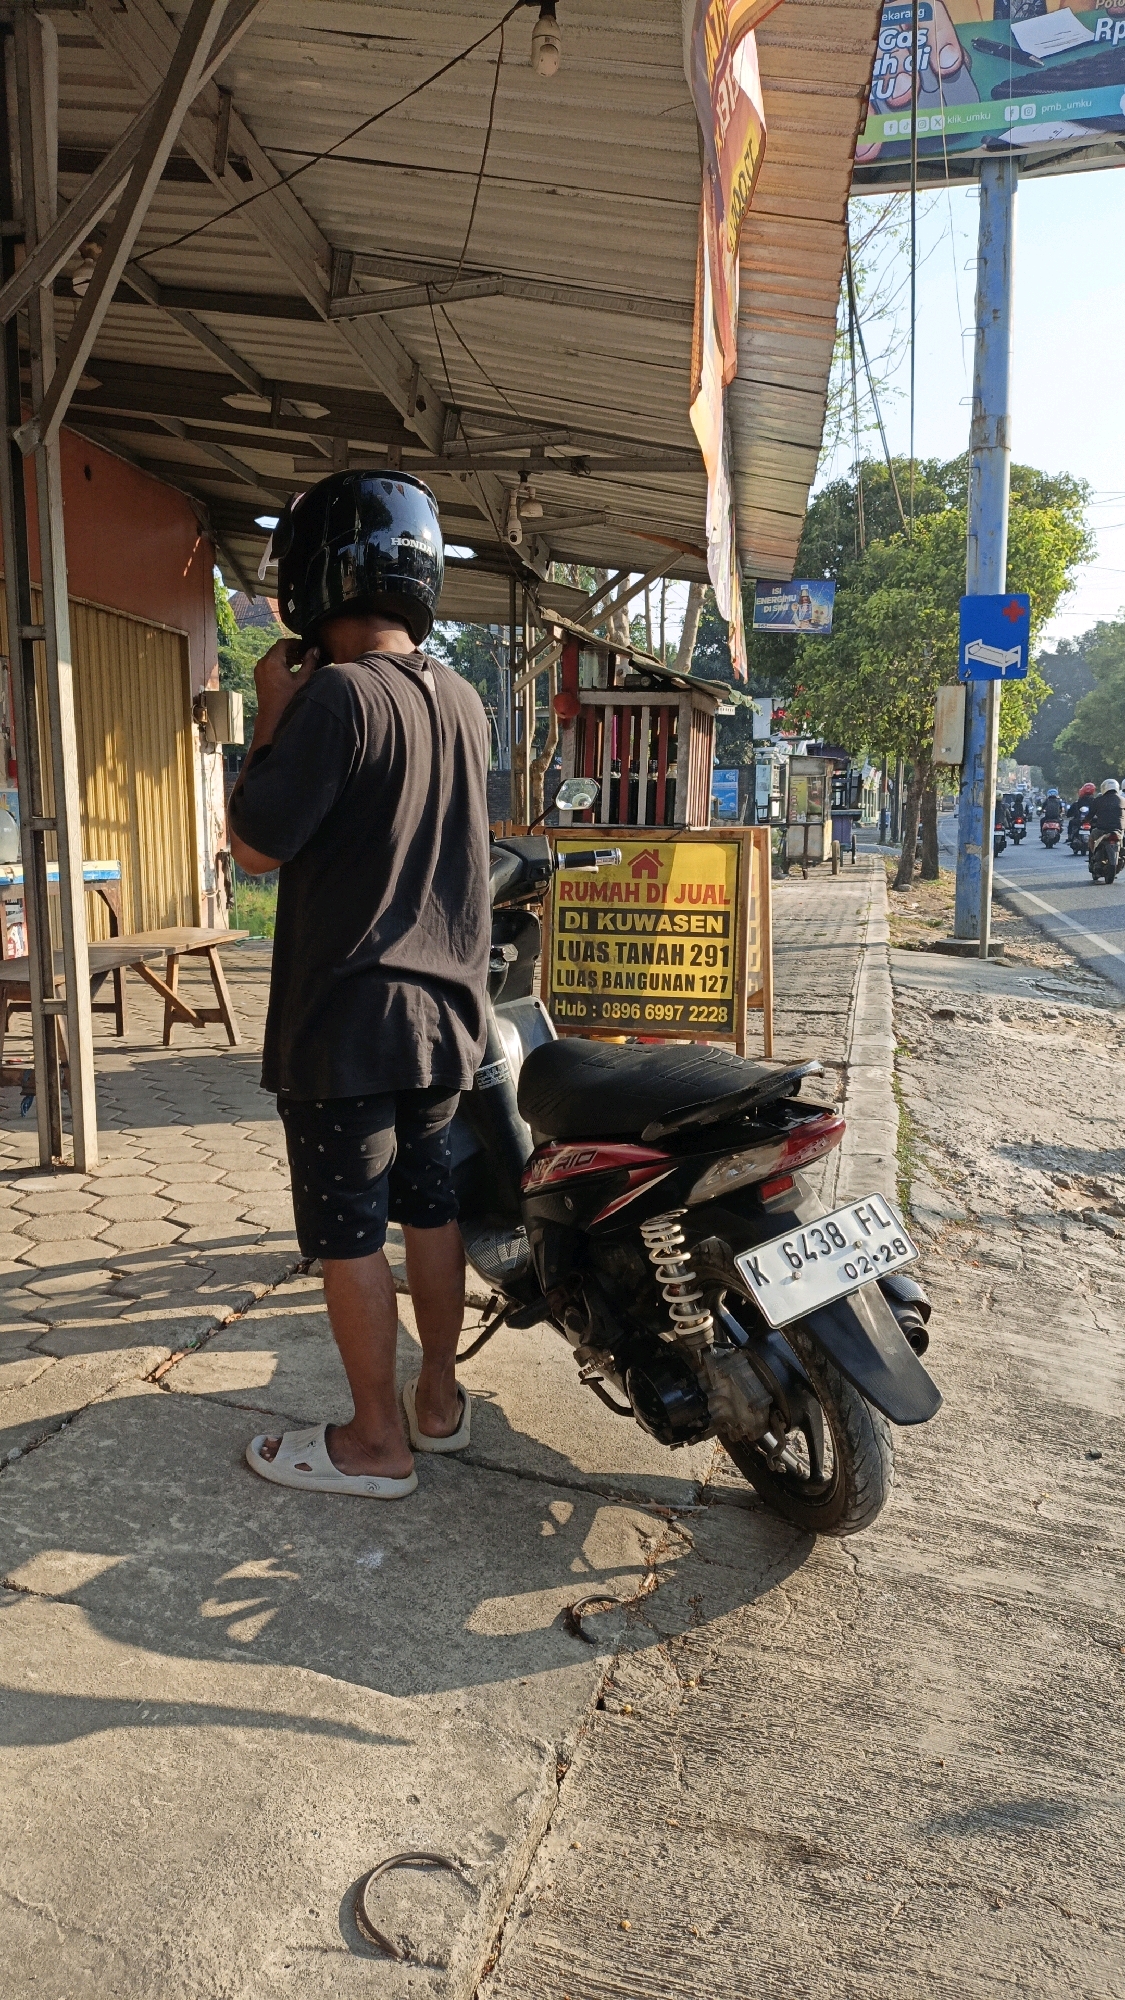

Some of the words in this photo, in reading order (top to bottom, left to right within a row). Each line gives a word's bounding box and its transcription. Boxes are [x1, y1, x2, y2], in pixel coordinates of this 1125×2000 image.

[879, 28, 929, 51] Gas
[1094, 17, 1125, 46] Rp
[947, 111, 991, 124] klik_umku
[1041, 99, 1092, 115] pmb_umku
[390, 537, 433, 557] HONDA
[756, 593, 797, 605] ENERGIMU
[772, 587, 782, 595] ISI
[763, 605, 772, 613] DI
[772, 602, 789, 612] SINI
[559, 880, 640, 904] RUMAH
[646, 882, 668, 904] DI
[673, 883, 731, 906] JUAL
[564, 911, 589, 930] DI
[597, 912, 724, 934] KUWASEN
[557, 940, 610, 964] LUAS
[615, 942, 685, 966] TANAH
[689, 943, 730, 968] 291
[556, 969, 598, 988] LUAS
[602, 971, 696, 992] BANGUNAN
[700, 975, 729, 994] 127
[554, 999, 587, 1017] Hub
[602, 1002, 641, 1019] 0896
[644, 1003, 684, 1021] 6997
[688, 1005, 728, 1023] 2228
[746, 1255, 771, 1287] K
[782, 1220, 848, 1269] 6438
[854, 1203, 892, 1236] FL
